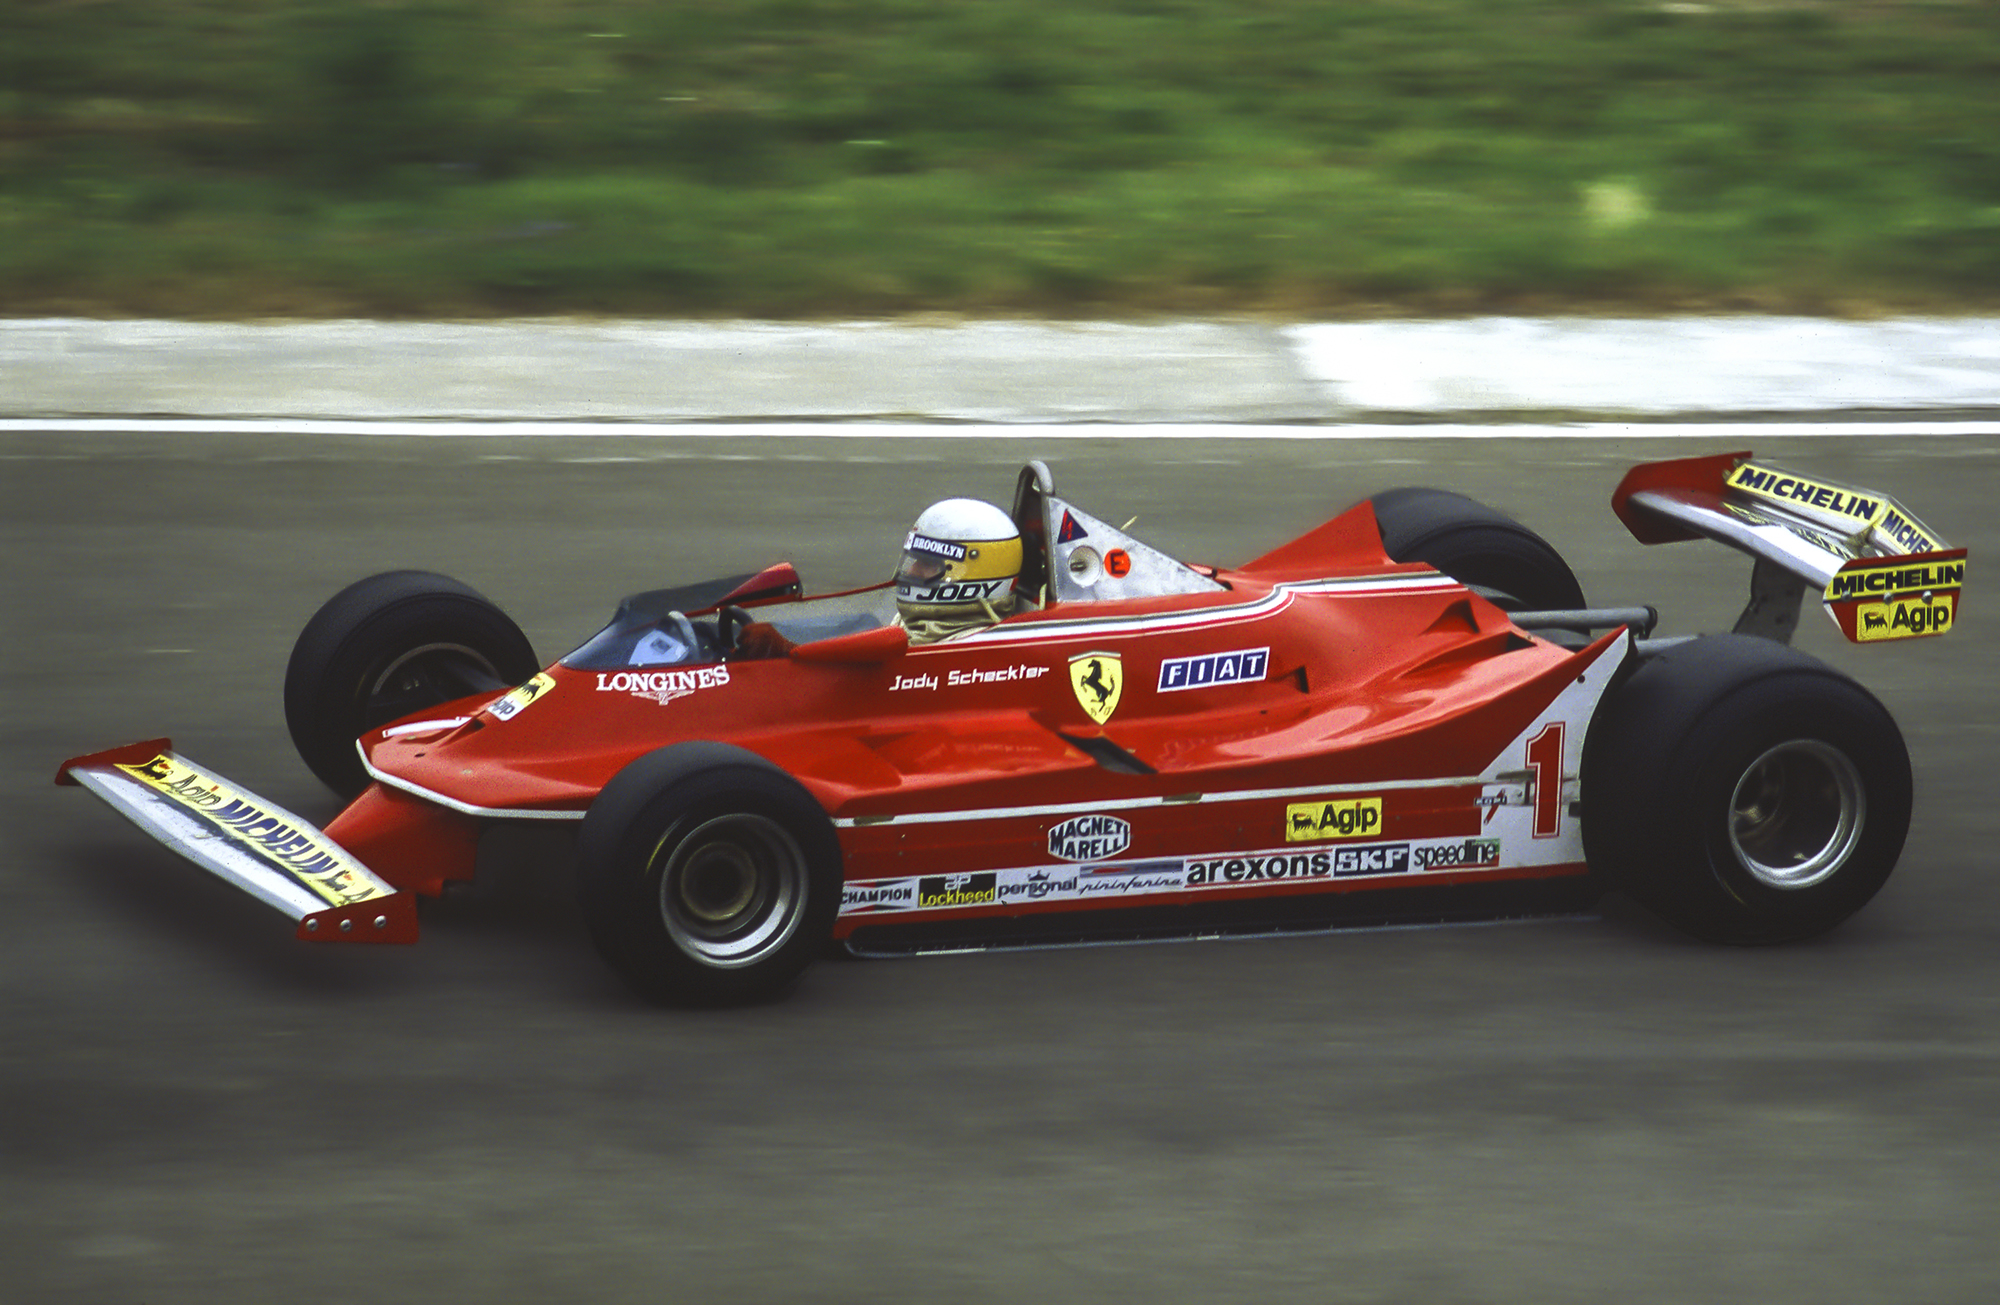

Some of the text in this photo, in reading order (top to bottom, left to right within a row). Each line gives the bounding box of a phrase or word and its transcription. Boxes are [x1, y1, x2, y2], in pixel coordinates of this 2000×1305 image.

[1737, 468, 1878, 521] MICHELIN
[913, 537, 965, 559] BROOKLYN
[1111, 554, 1126, 575] E
[916, 582, 1002, 601] JODY
[1832, 565, 1963, 595] MICHELIN
[1891, 602, 1949, 632] Agip
[596, 665, 730, 691] LONGINES
[888, 664, 1050, 691] Jody Scheckter
[1167, 655, 1263, 686] FIAT
[163, 774, 221, 806] Agip
[1525, 721, 1565, 839] 1
[1050, 817, 1128, 846] MAGNETI
[1319, 802, 1378, 834] Agip
[201, 798, 339, 876] MICHELIN
[1050, 829, 1128, 859] MARELLI
[1336, 848, 1407, 872] SKF
[1413, 839, 1497, 867] speedline
[1186, 853, 1331, 885] arexons
[841, 887, 912, 905] CHAMPION
[920, 886, 994, 907] Lockheed
[998, 876, 1078, 899] personal
[1079, 876, 1182, 895] pininfarina
